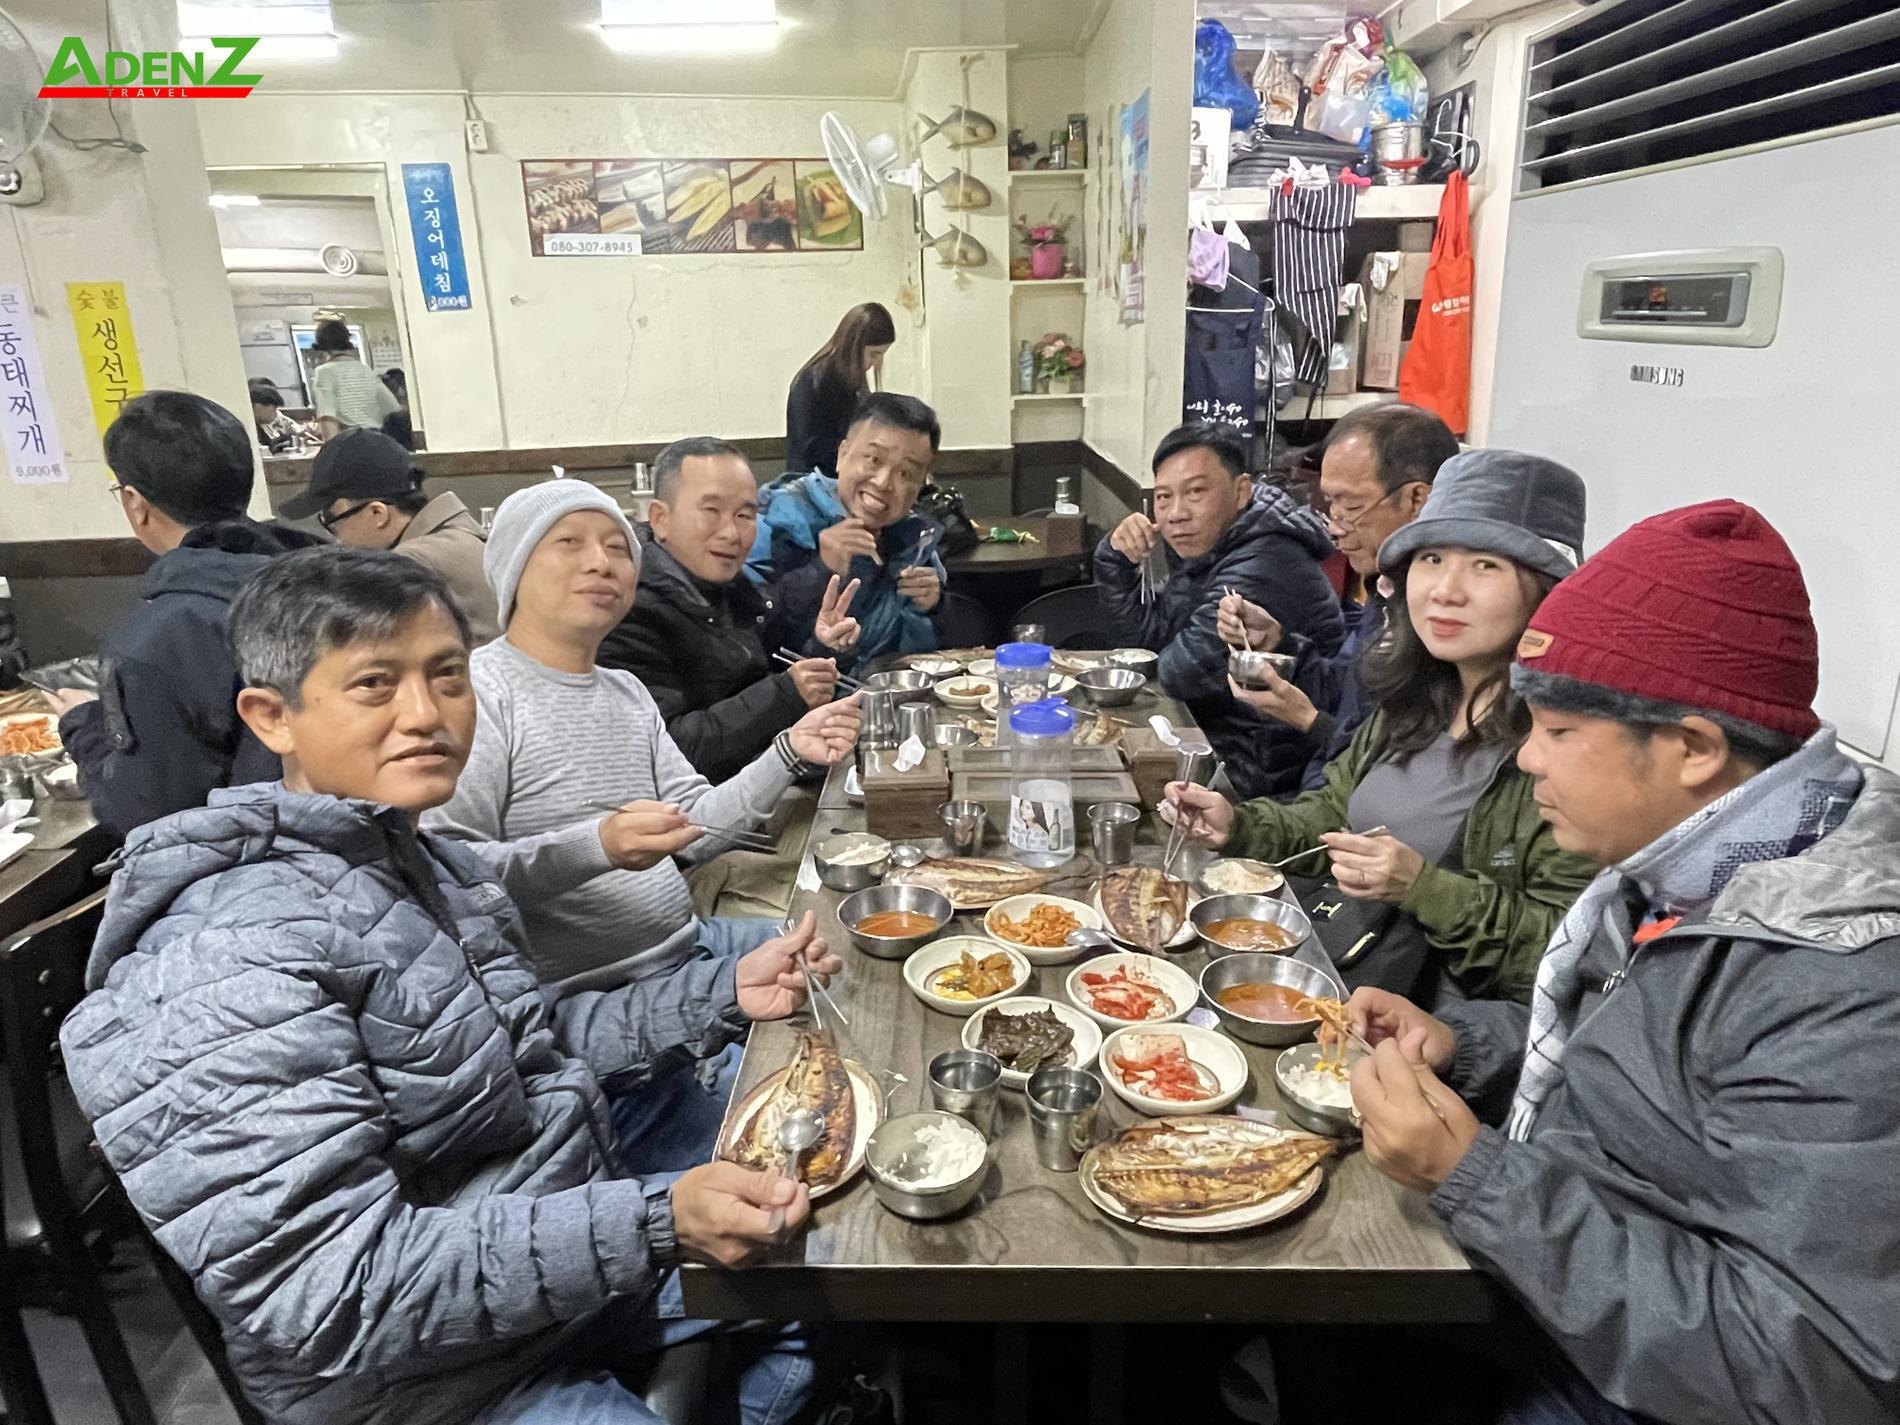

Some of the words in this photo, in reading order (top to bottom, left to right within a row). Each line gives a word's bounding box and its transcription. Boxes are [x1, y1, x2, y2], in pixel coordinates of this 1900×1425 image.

[420, 187, 452, 293] 오징어데침
[551, 241, 633, 253] 080-307-8945
[0, 323, 47, 456] 동태찌개
[92, 317, 130, 411] 생선구
[1630, 364, 1685, 387] SAMSUNG
[15, 464, 62, 478] 9,000원
